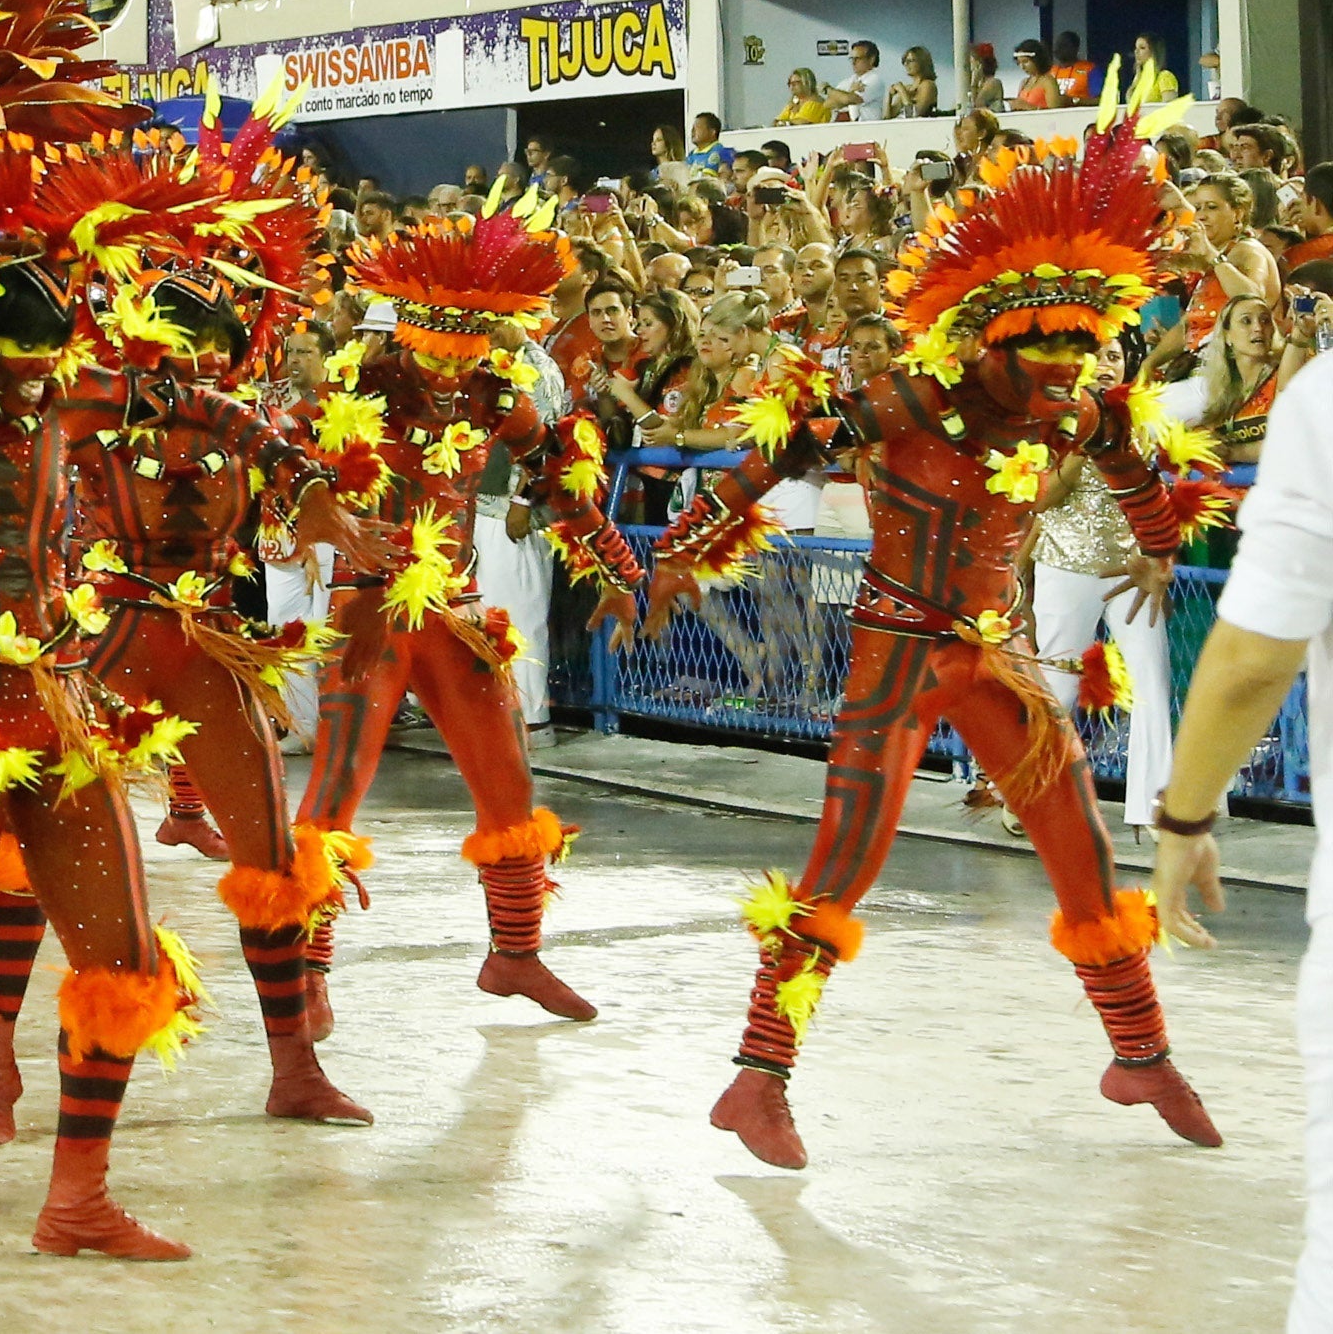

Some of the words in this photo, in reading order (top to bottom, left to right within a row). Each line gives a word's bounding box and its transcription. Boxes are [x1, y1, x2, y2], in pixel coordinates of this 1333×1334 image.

[284, 39, 431, 92] SWISSAMBA
[520, 2, 676, 92] TIJUCA
[305, 92, 333, 113] conto
[336, 87, 380, 109] marcado
[383, 90, 396, 105] no
[399, 86, 433, 107] tempo
